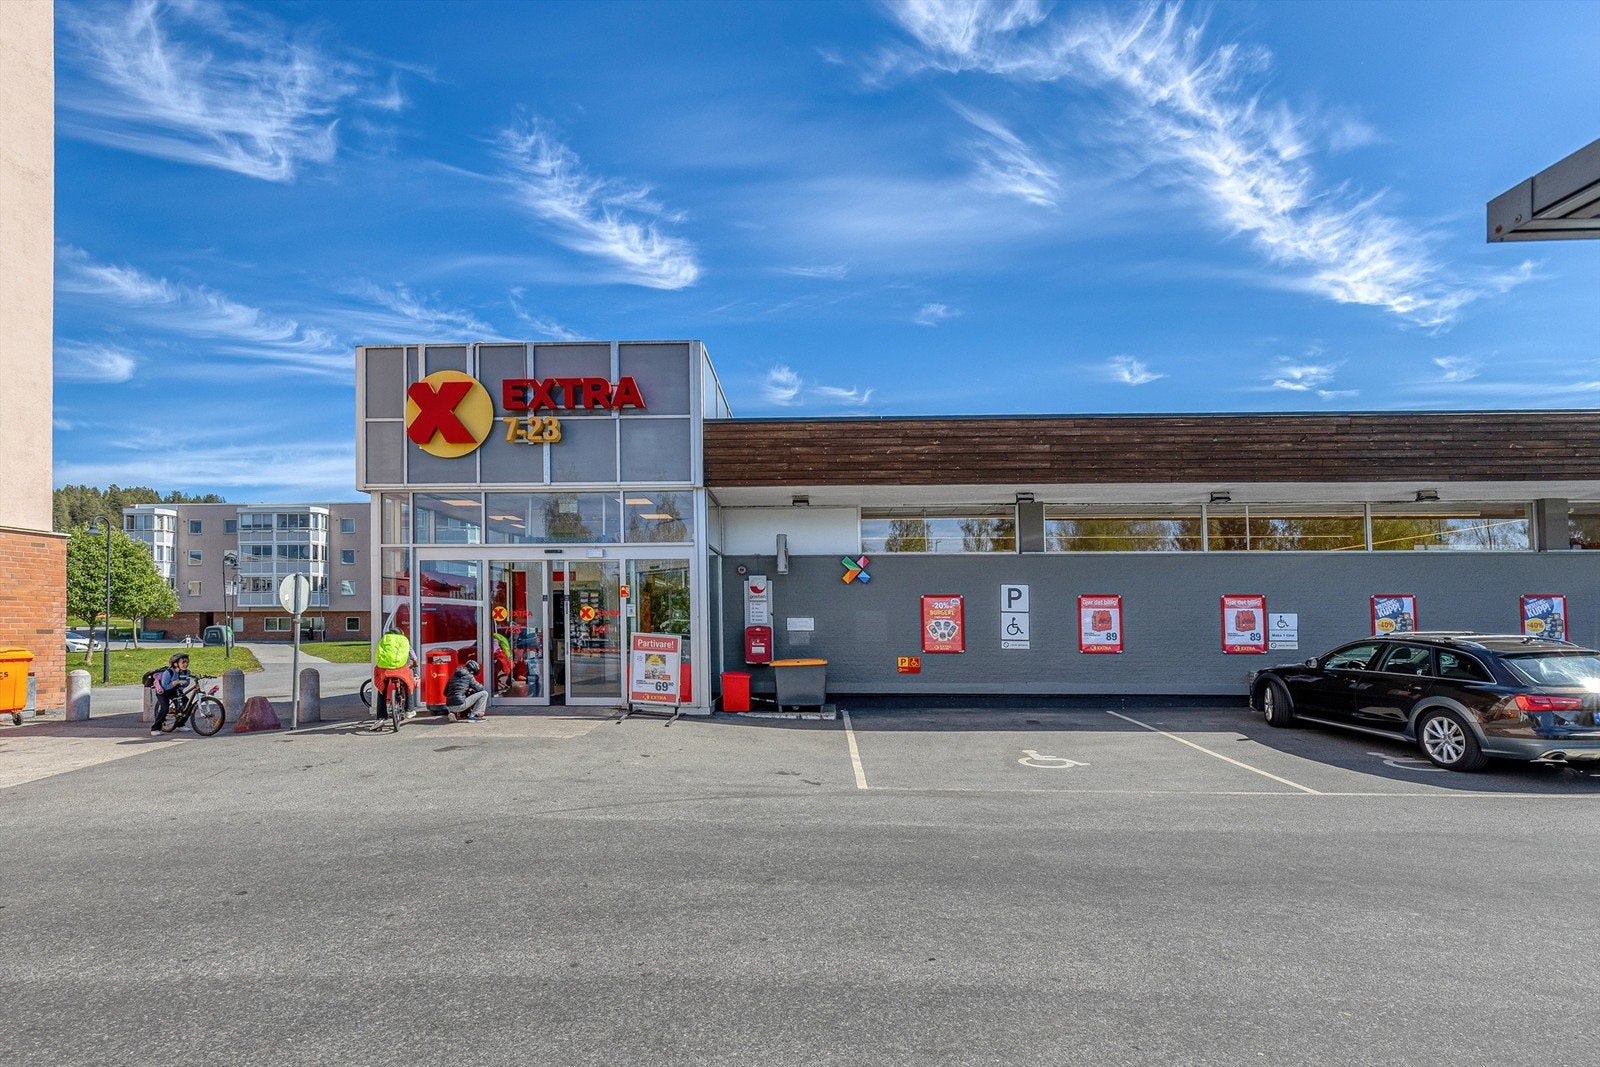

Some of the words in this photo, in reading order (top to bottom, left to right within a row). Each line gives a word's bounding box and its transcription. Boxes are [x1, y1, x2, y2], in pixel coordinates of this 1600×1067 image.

[407, 381, 478, 444] X
[502, 376, 646, 411] EXTRA
[503, 416, 562, 444] 7-23
[1008, 588, 1022, 608] P
[1377, 602, 1402, 617] KUPP!
[1526, 602, 1551, 617] KUPP!
[1379, 621, 1394, 629] -40%
[1528, 621, 1544, 629] -40%
[1106, 632, 1118, 641] 89
[1250, 632, 1261, 641] 89
[637, 639, 674, 649] Partivare!
[900, 657, 907, 667] P
[655, 681, 668, 691] 69
